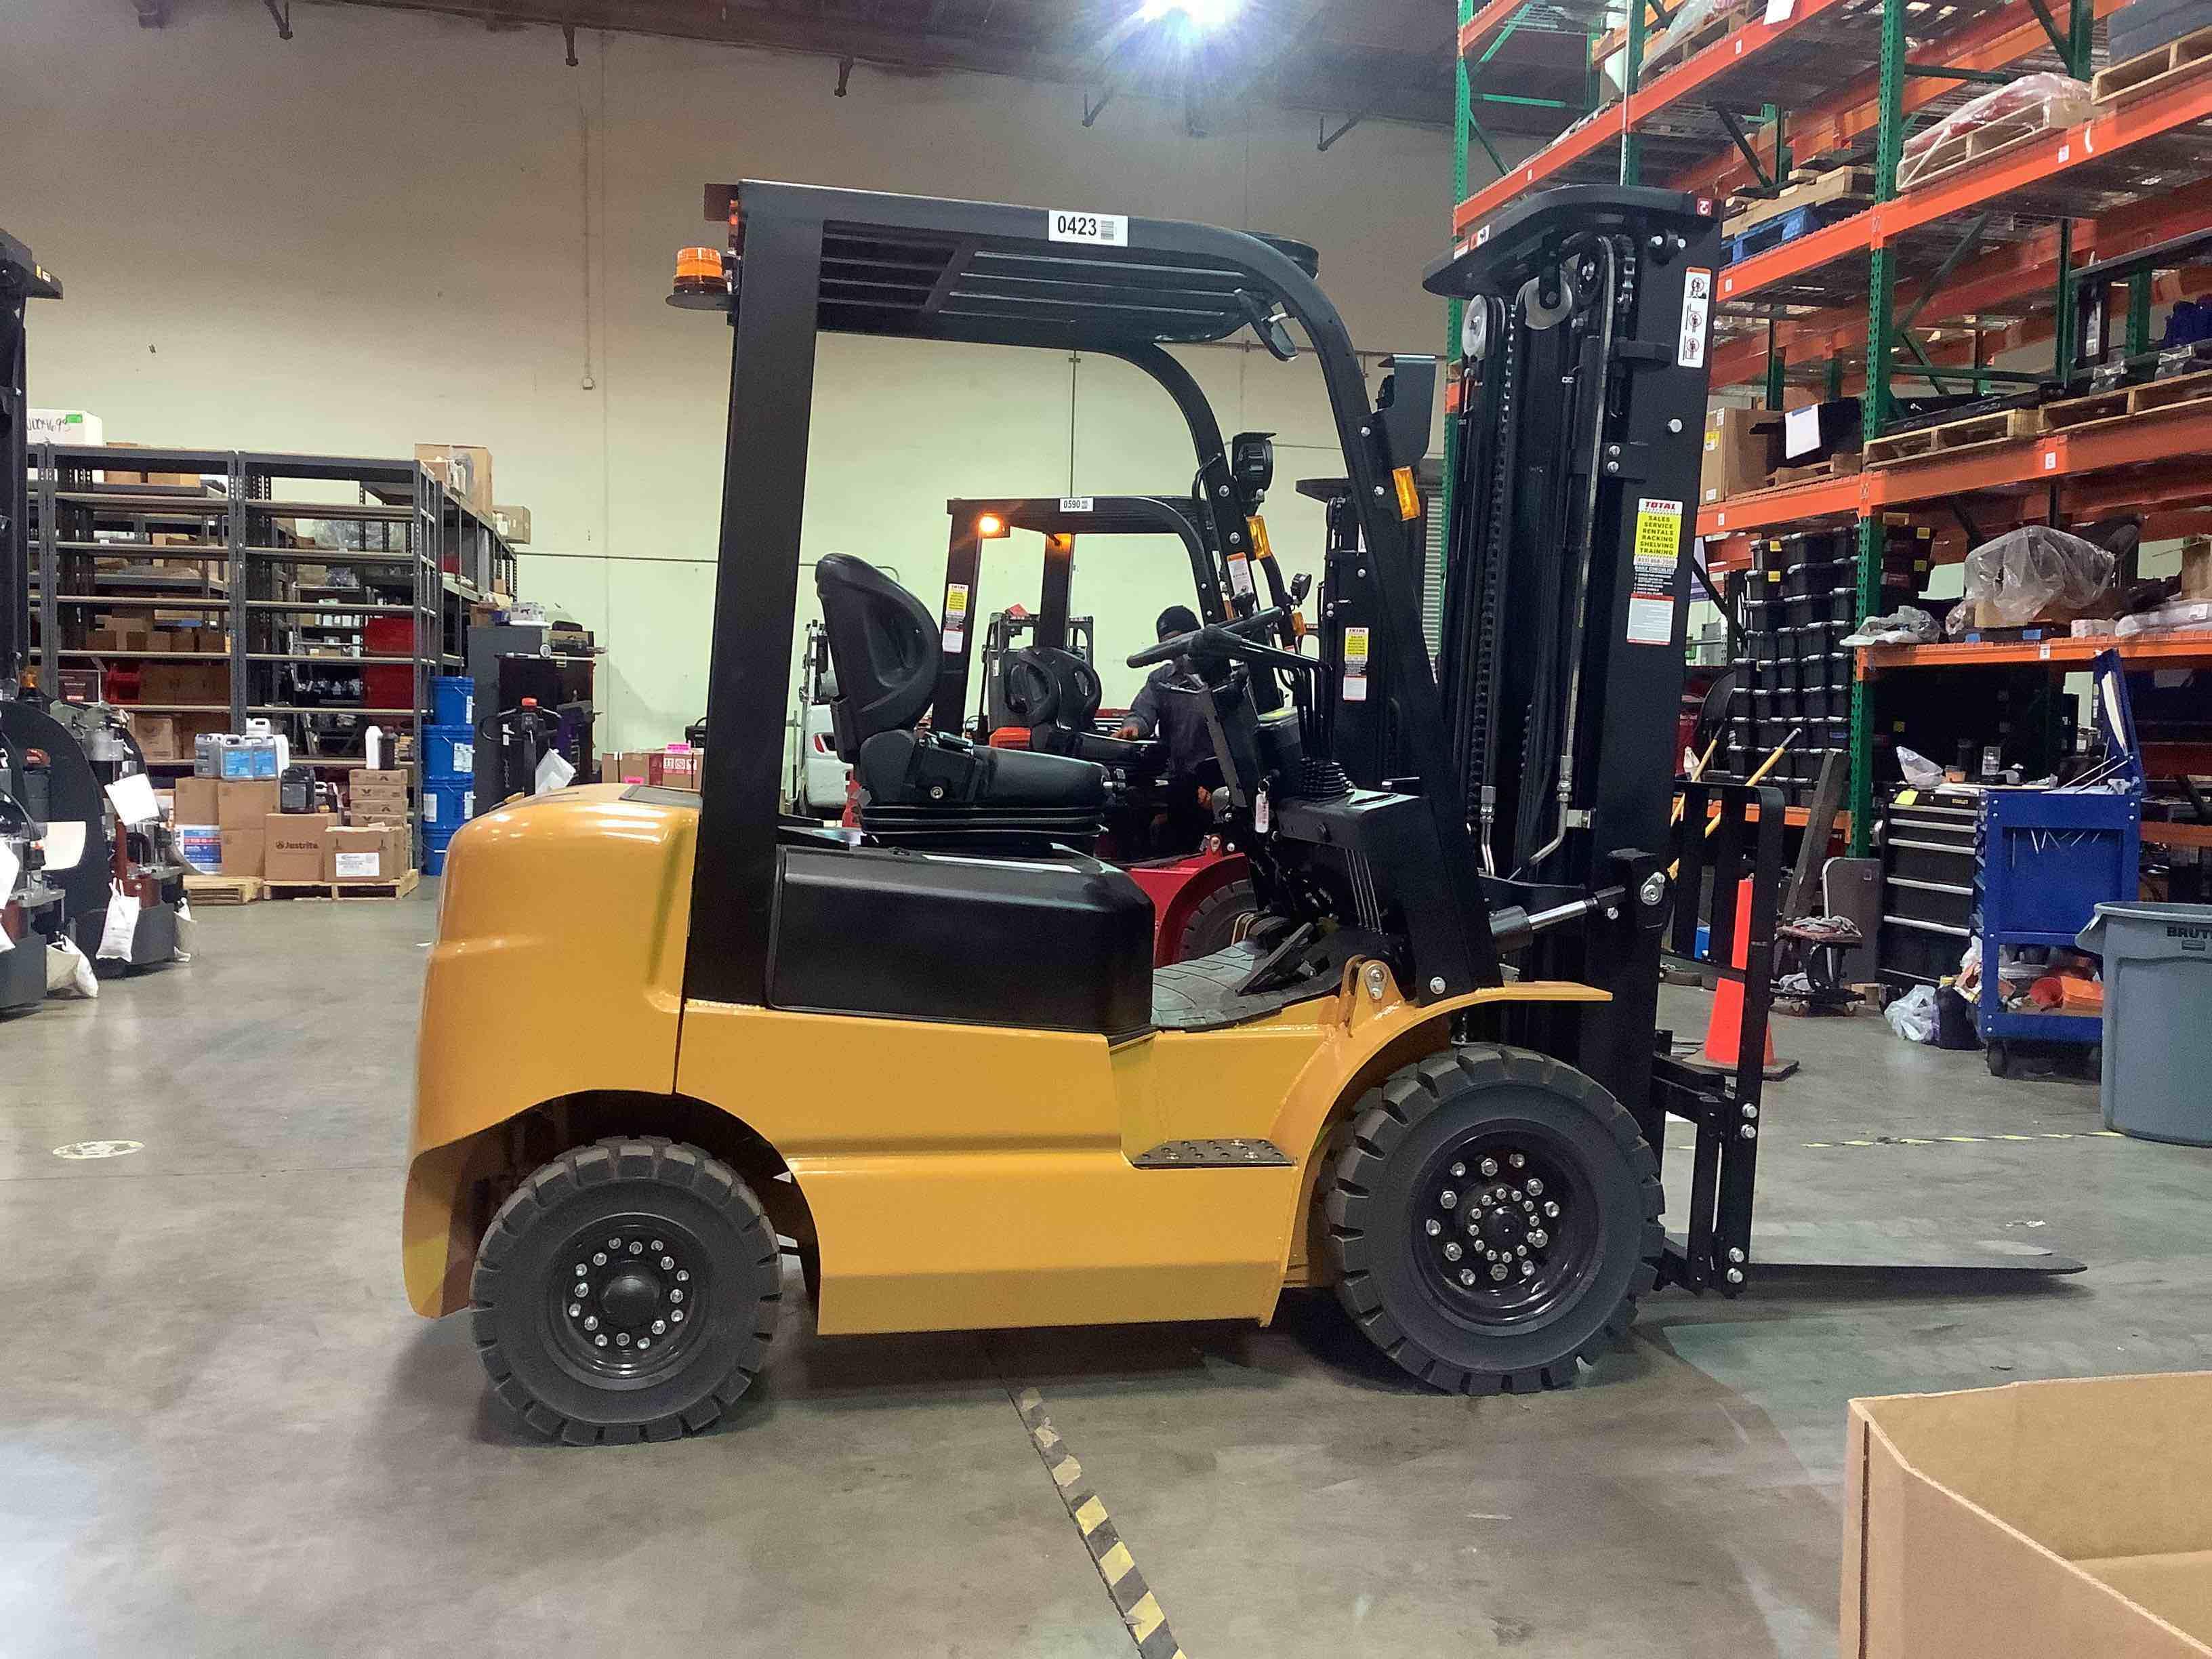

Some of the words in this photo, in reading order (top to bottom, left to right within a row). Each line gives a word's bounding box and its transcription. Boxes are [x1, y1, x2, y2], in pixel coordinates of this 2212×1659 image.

[1057, 216, 1097, 236] 0423
[1063, 500, 1081, 509] 0590
[1645, 501, 1675, 510] TOTAL
[2167, 926, 2212, 939] BRUT
